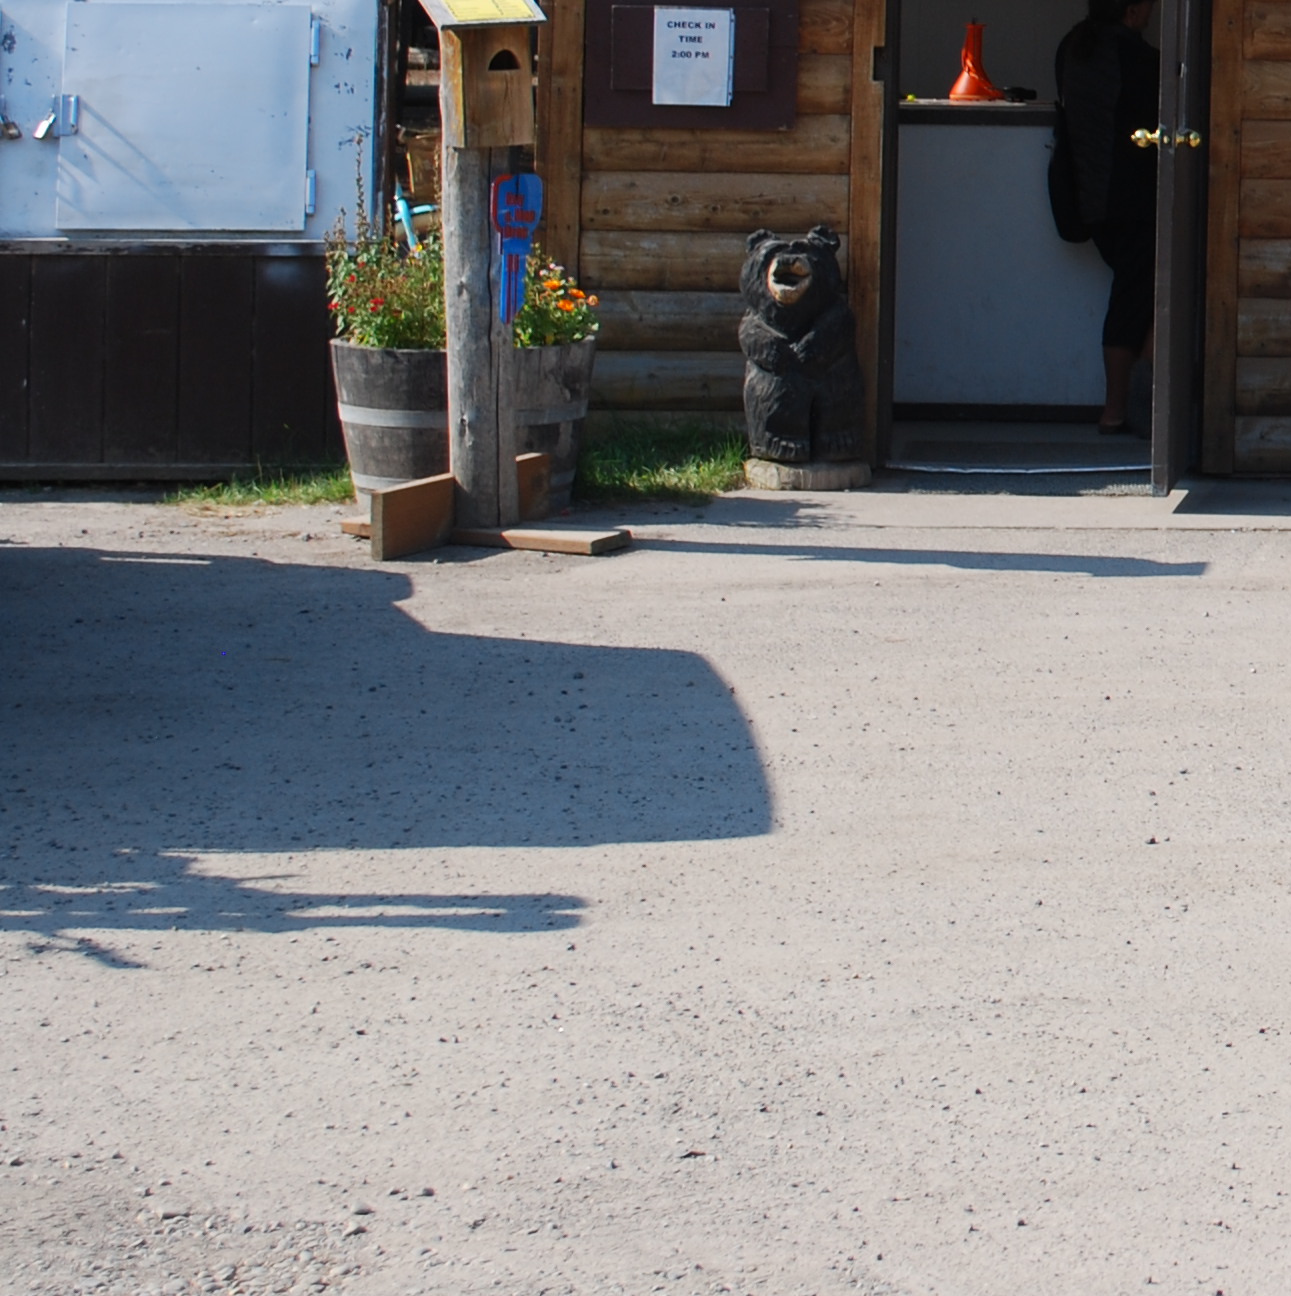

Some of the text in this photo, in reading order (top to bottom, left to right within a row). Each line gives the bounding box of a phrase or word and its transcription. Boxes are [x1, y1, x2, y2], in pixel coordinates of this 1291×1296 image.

[667, 20, 716, 30] CHECK IN
[678, 35, 703, 43] TIME
[671, 50, 710, 59] 2:00 PM
